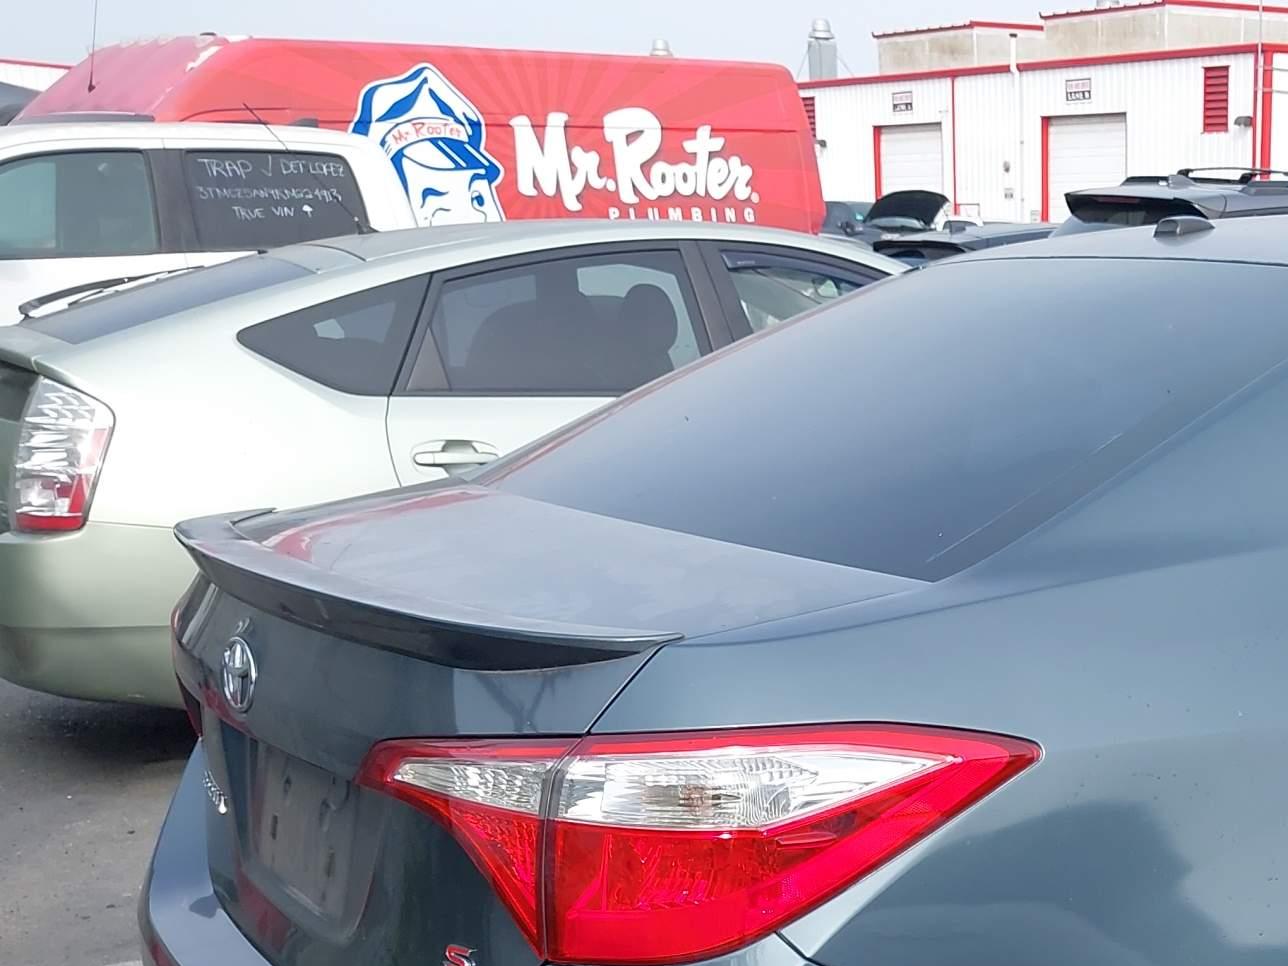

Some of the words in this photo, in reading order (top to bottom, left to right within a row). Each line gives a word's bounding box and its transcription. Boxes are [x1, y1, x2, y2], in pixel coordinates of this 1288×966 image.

[508, 111, 617, 212] Mr.
[602, 106, 760, 204] Rooter.
[197, 158, 252, 179] TRAP
[271, 205, 295, 217] VIN
[607, 207, 756, 223] PLUMBING
